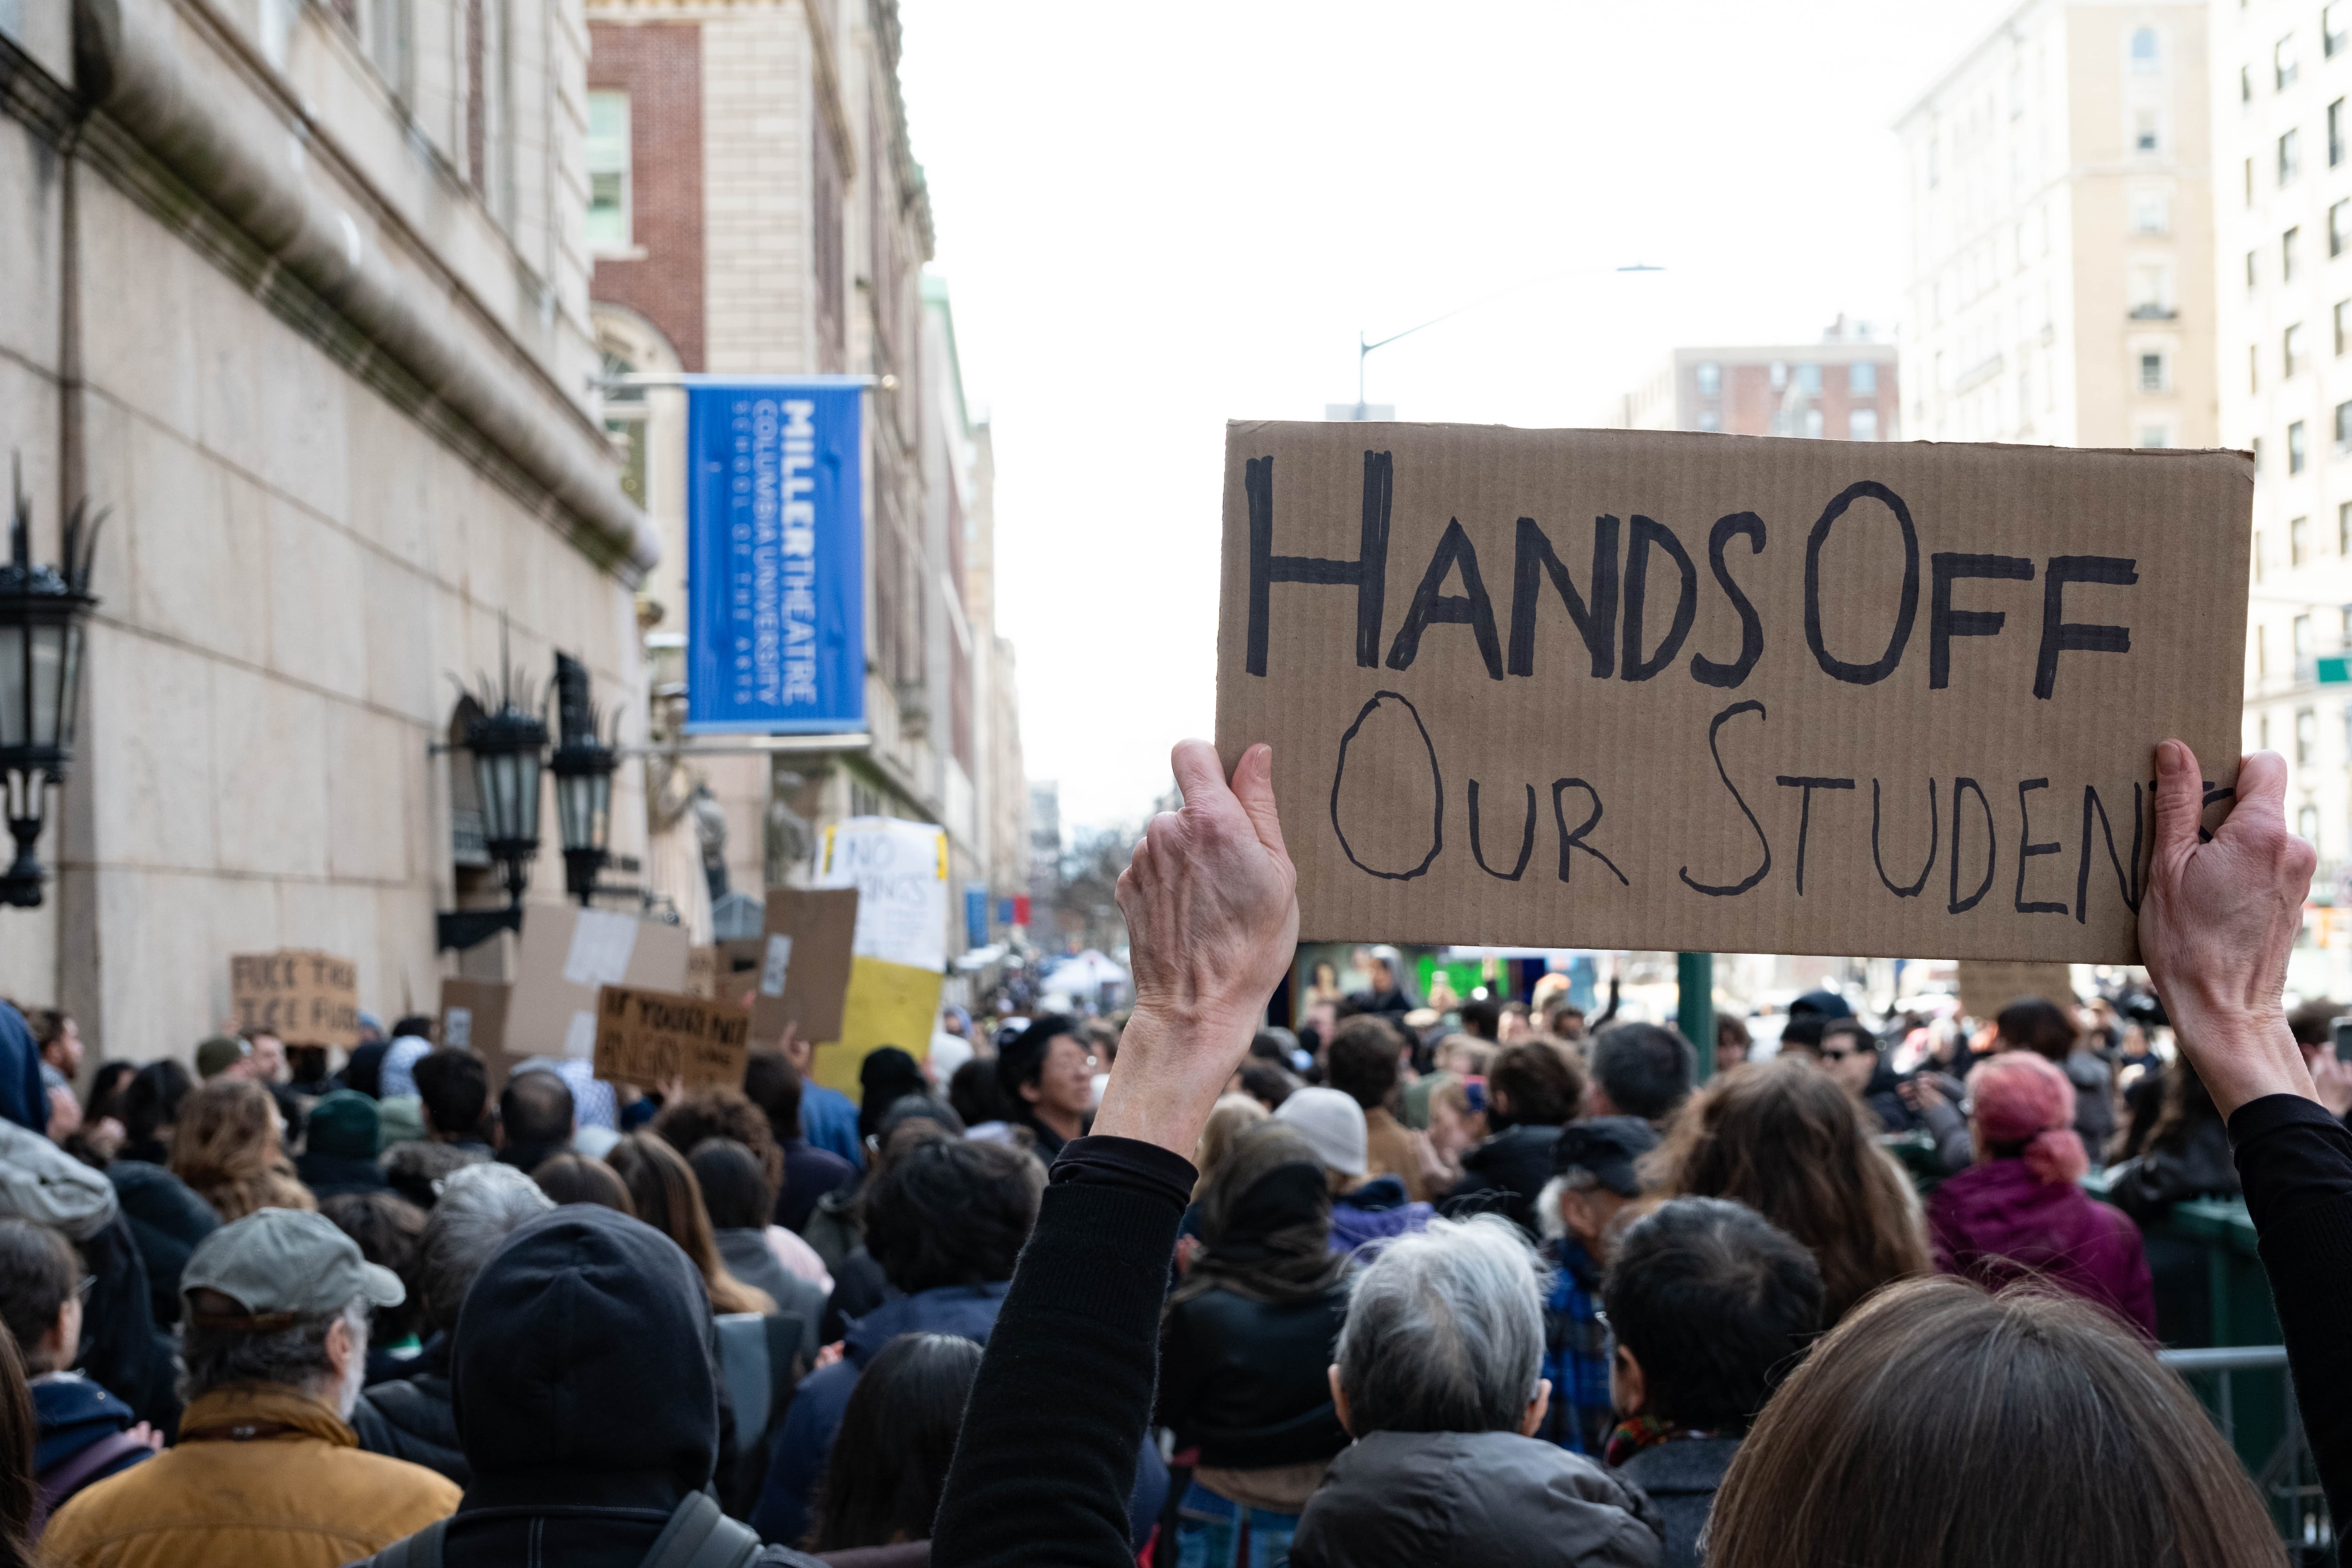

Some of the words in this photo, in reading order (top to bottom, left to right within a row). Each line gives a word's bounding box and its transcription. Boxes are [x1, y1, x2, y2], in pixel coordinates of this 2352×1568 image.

[753, 399, 779, 543] COLUMBIA
[780, 399, 816, 556] MILLER
[754, 545, 780, 706] UNIVERSITY
[781, 556, 818, 706] THEATRE
[1245, 450, 1759, 689] HANDS
[1804, 480, 2139, 700] OFF
[848, 837, 895, 867] NO
[1330, 690, 1629, 885] OUR
[233, 958, 295, 990] FUCK
